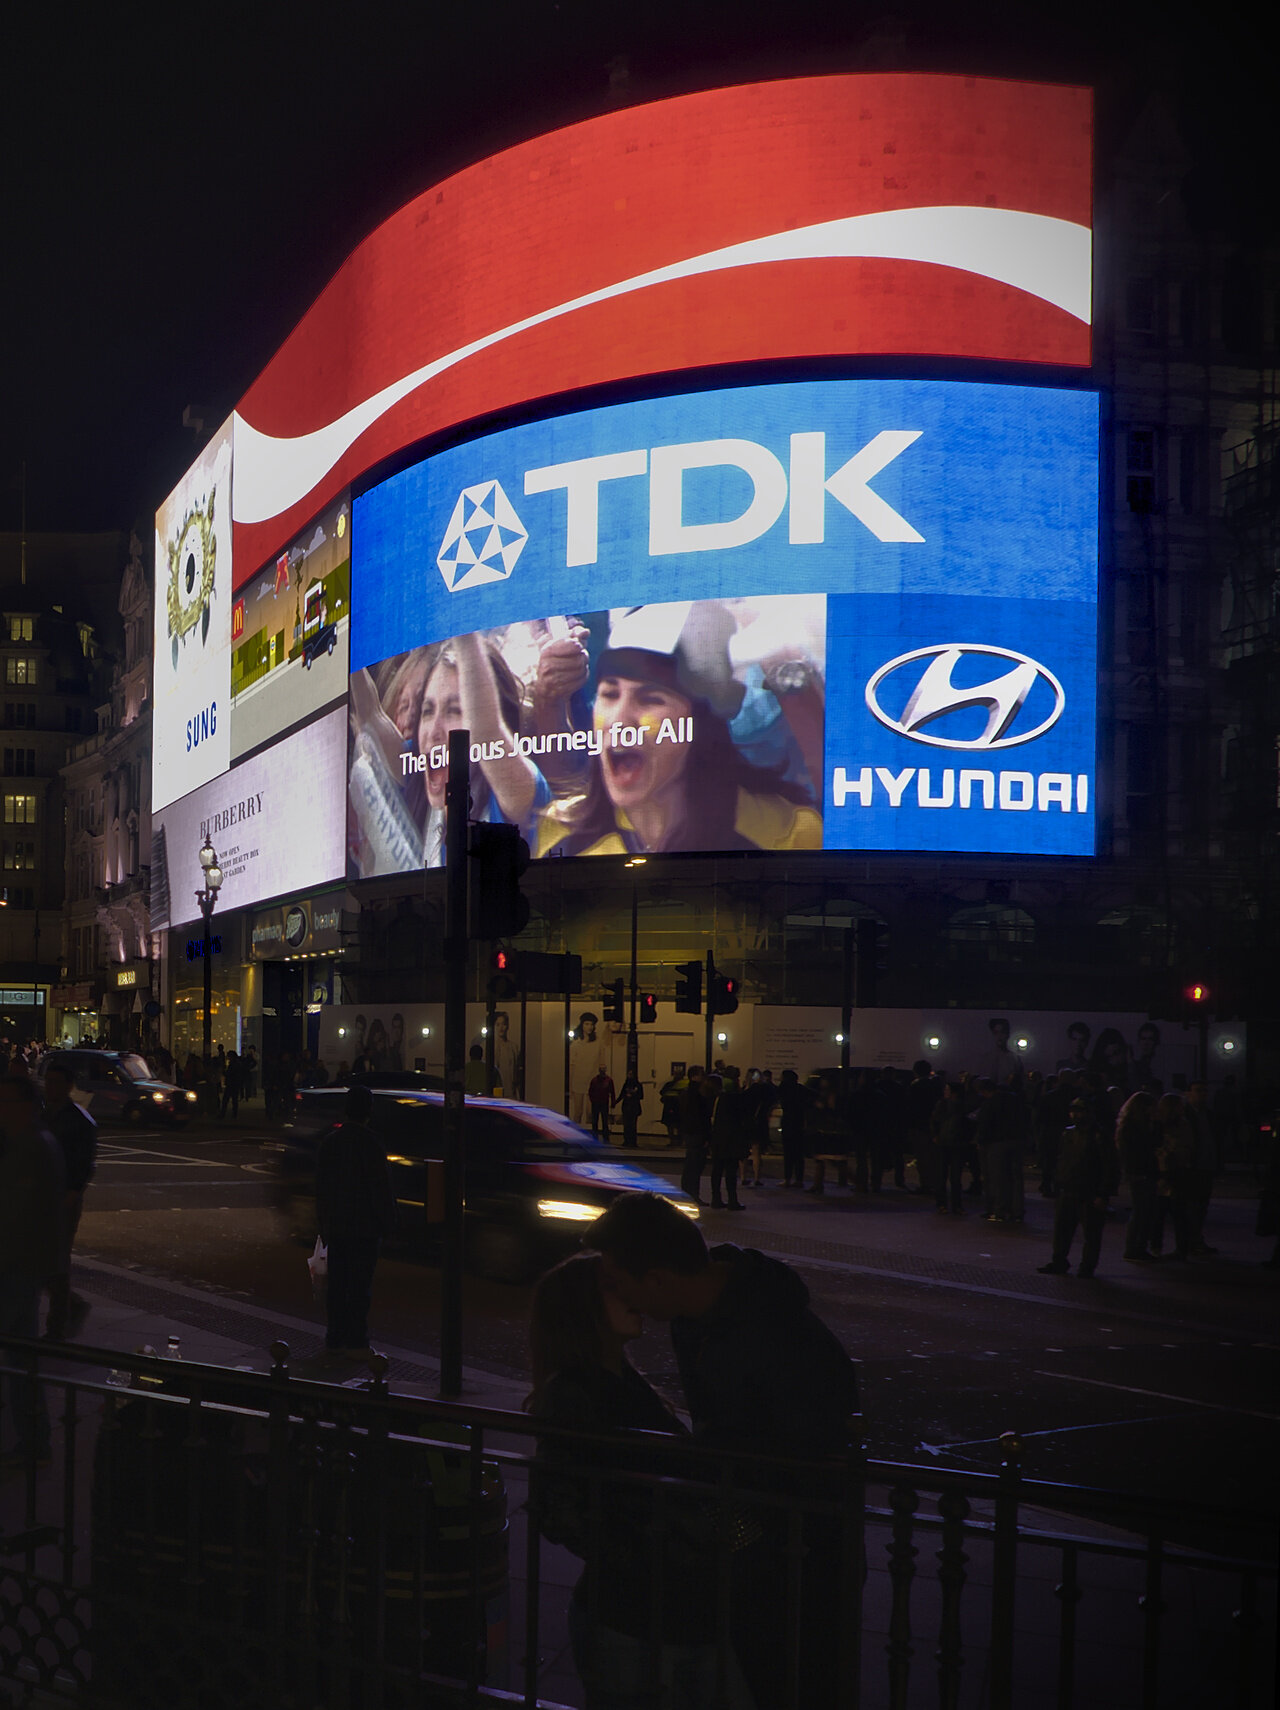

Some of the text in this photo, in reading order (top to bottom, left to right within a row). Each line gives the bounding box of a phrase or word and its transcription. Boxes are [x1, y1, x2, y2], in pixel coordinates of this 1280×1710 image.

[524, 430, 926, 567] TDK
[186, 701, 217, 752] SUNG
[399, 717, 694, 776] The Glous Journey for All
[833, 767, 1089, 813] HYUNDAI
[200, 791, 265, 840] BURBERRY
[252, 924, 282, 944] pharmacy
[314, 908, 340, 931] beauty
